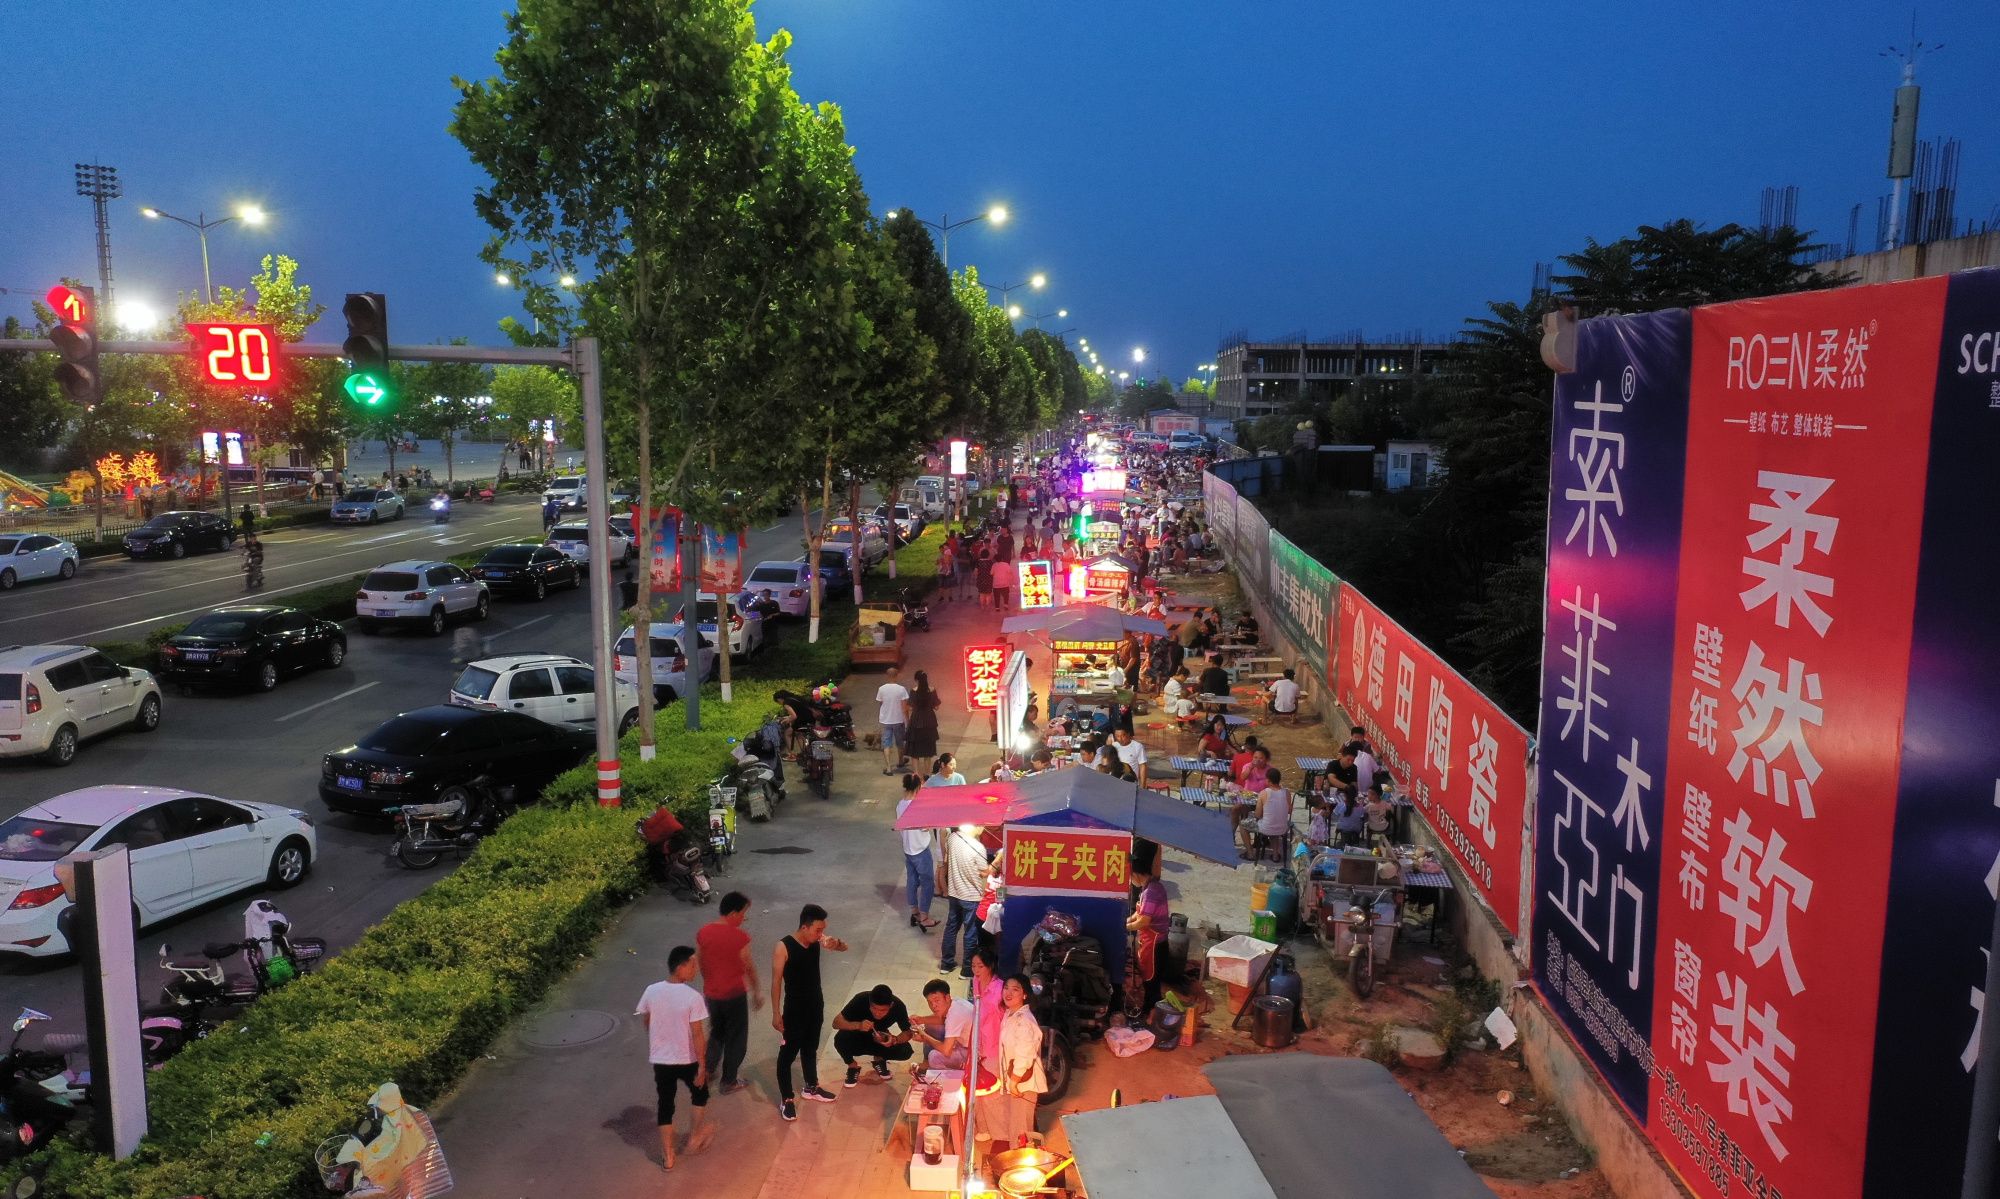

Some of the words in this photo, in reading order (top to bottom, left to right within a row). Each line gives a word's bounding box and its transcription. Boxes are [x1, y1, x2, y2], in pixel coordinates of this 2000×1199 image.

[207, 327, 272, 381] 20
[1813, 326, 1869, 389] 柔然
[1749, 411, 1766, 434] 壁纸
[1771, 411, 1789, 436] 布艺
[1792, 412, 1834, 438] 整体软装
[1367, 621, 1499, 850] 德田陶瓷
[1687, 621, 1725, 755] 壁纸
[1012, 839, 1126, 885] 饼子夹肉
[1436, 803, 1492, 890] 13753925818
[1607, 736, 1651, 990] 木门
[1678, 782, 1712, 911] 壁布
[1706, 469, 1839, 1163] 柔然软装
[1671, 938, 1702, 1065] 窗帘
[1660, 1097, 1729, 1198] 13303597885
